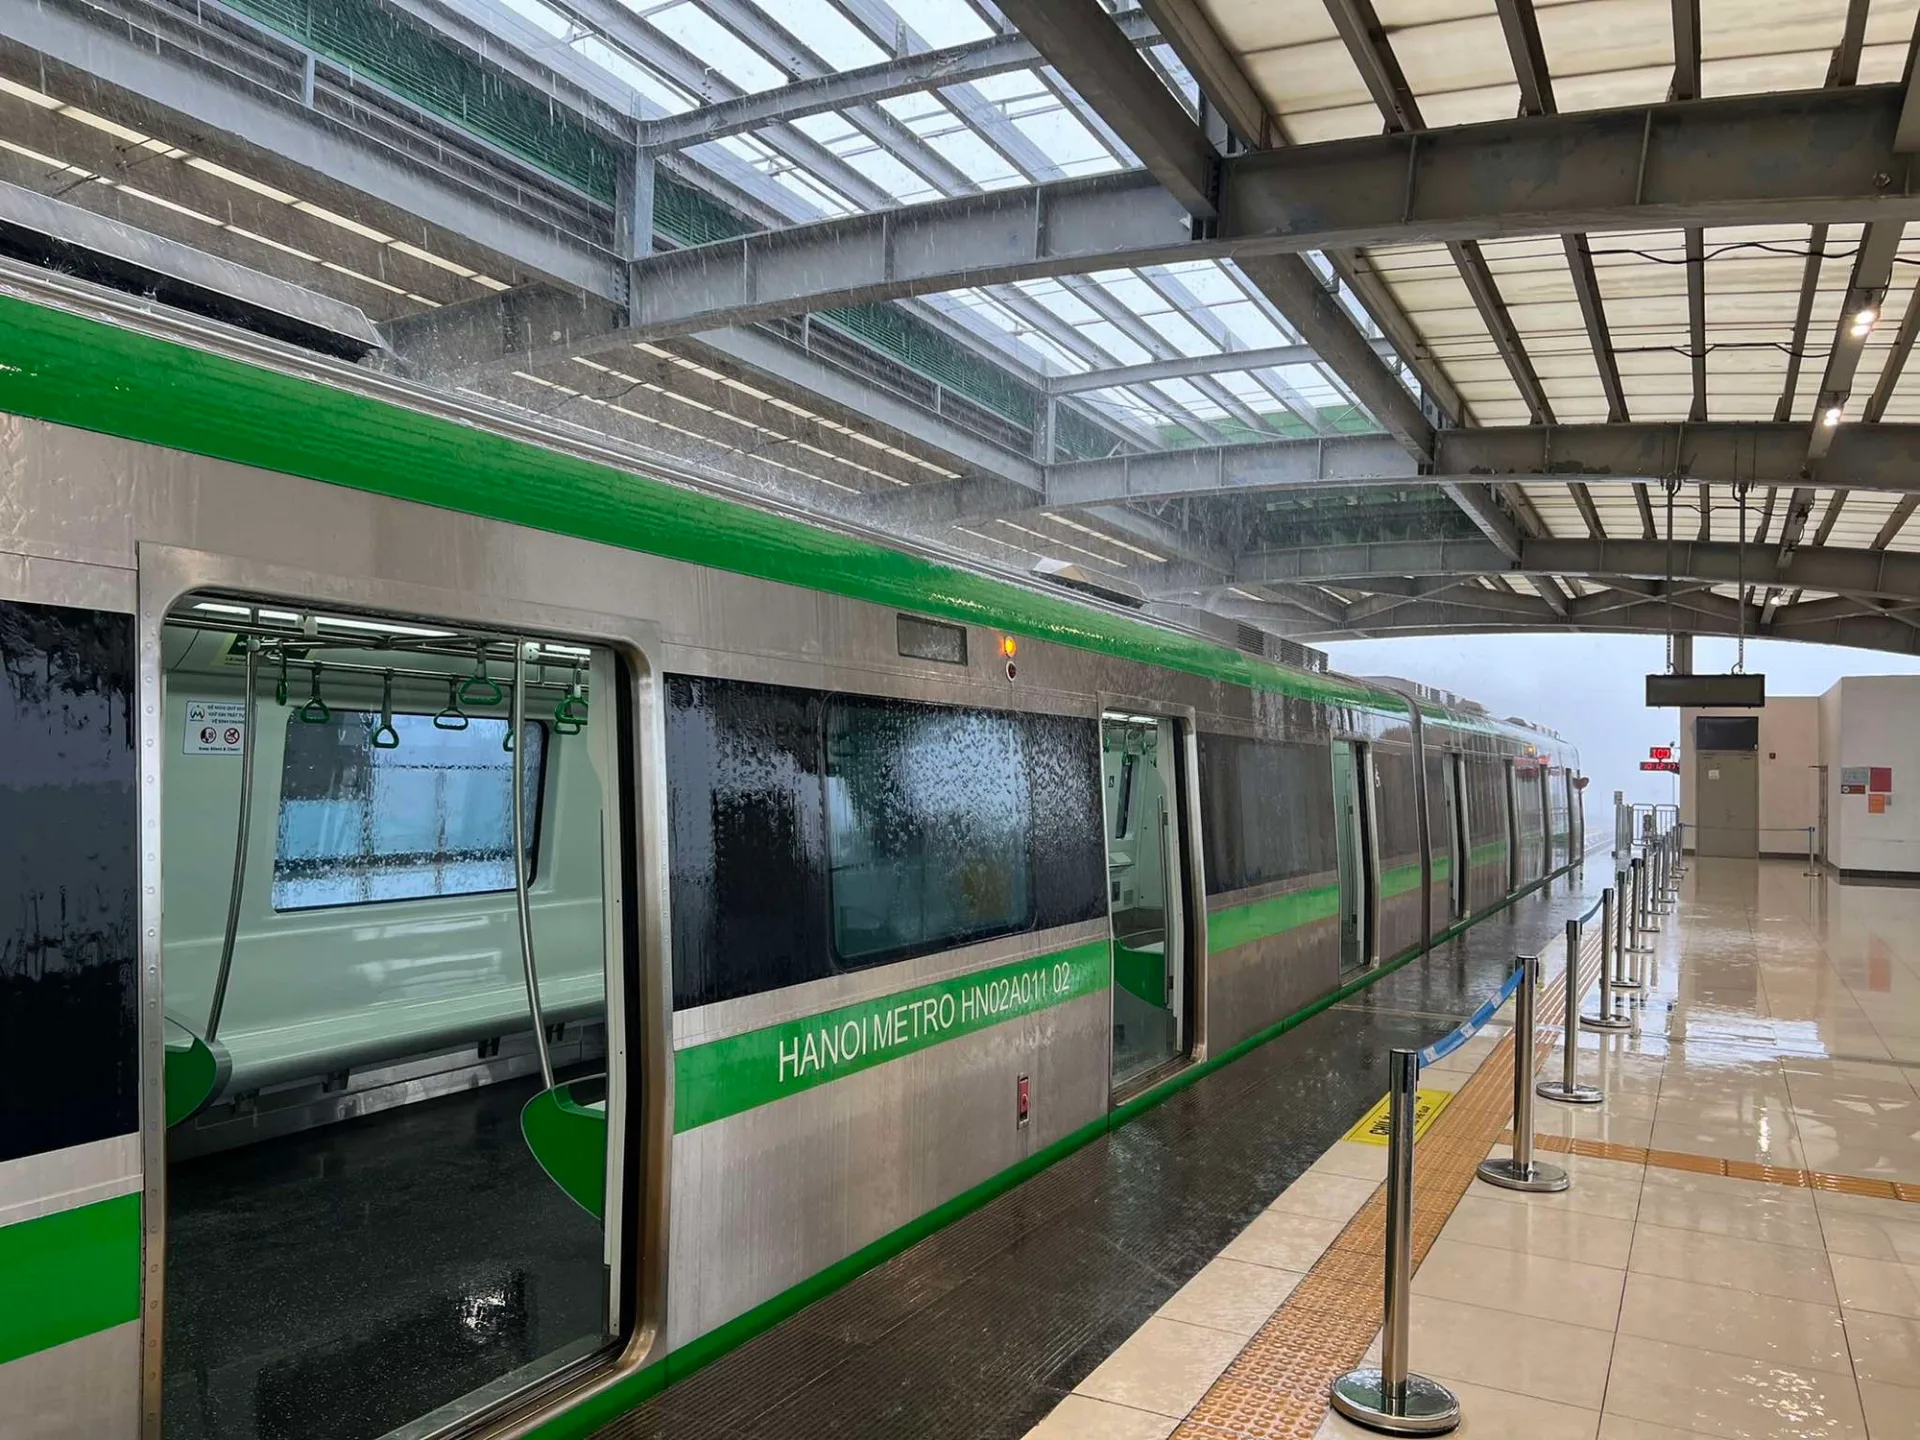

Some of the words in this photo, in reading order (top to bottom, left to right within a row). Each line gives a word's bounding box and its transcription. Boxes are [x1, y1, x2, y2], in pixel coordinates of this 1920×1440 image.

[778, 1016, 867, 1083] HANOI
[872, 993, 956, 1051] METRO
[960, 967, 1048, 1023] HN02A011
[1052, 961, 1071, 994] 02
